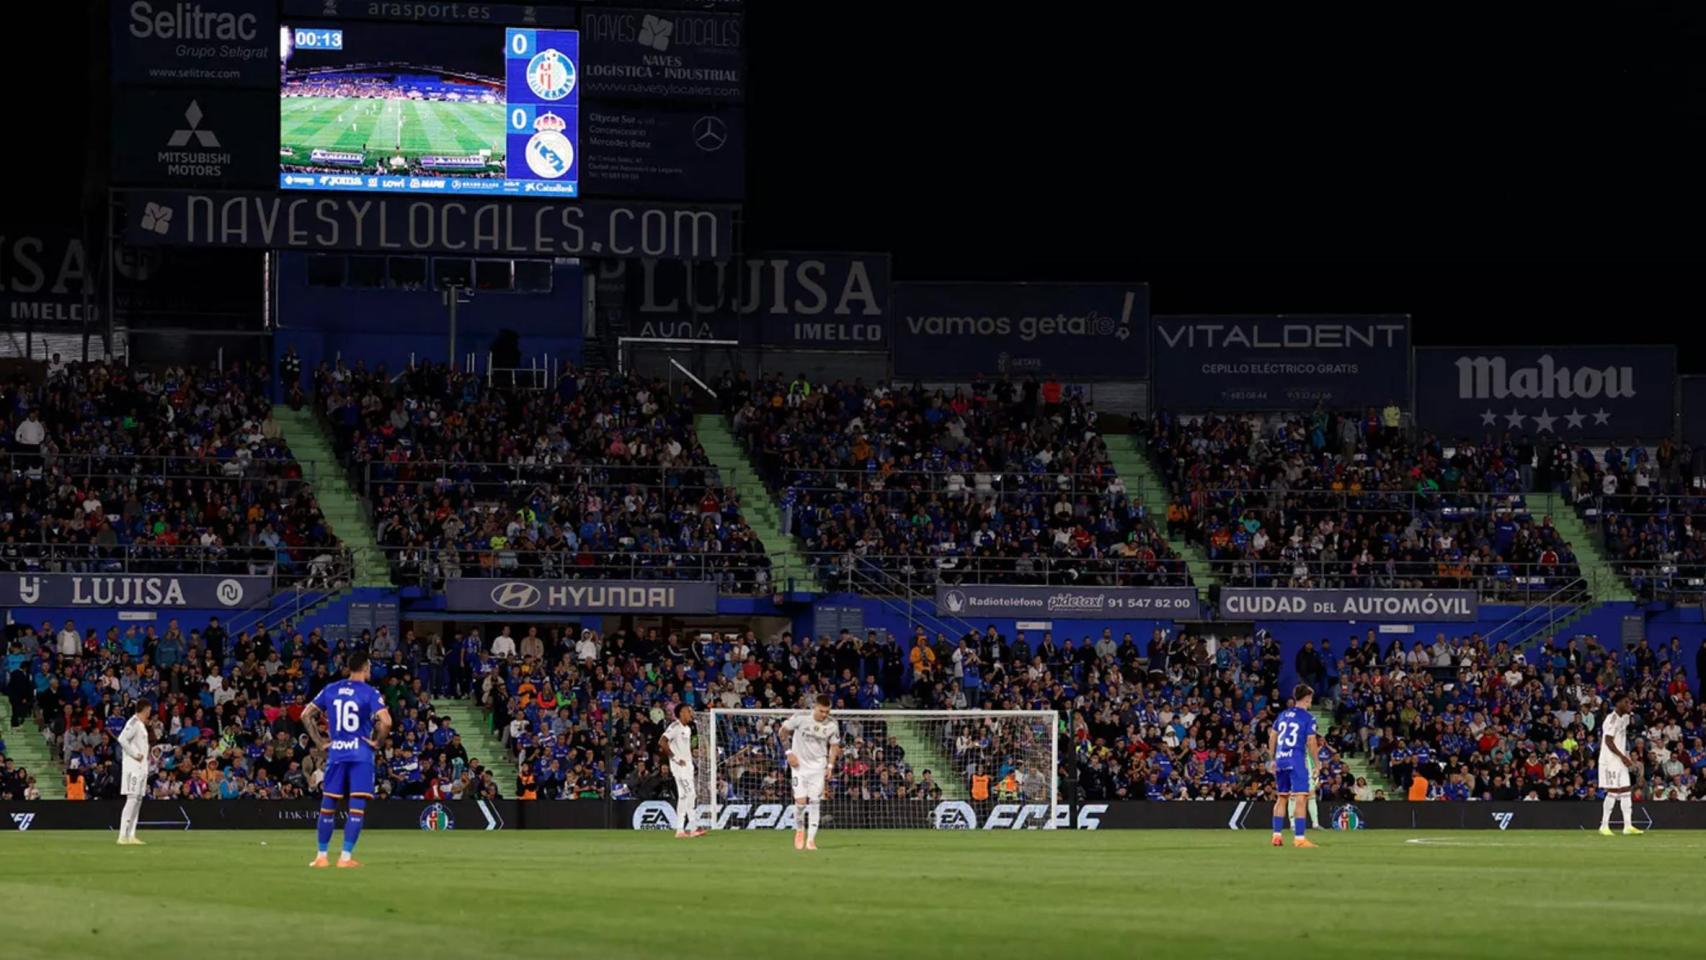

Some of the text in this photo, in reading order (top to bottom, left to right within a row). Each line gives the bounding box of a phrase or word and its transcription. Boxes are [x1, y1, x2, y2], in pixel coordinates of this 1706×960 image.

[129, 1, 257, 41] Selitrac
[368, 2, 491, 21] arasport.es
[296, 31, 342, 48] 00:13
[586, 14, 741, 48] NAVES LOCALES
[176, 44, 216, 59] Grupo
[512, 33, 528, 55] 0
[642, 55, 683, 68] NAVES
[150, 68, 240, 79] www.selitrac.com
[664, 68, 739, 82] INDUSTRIAL
[587, 83, 741, 97] www.navesylocales.com
[512, 108, 527, 130] 0
[157, 152, 231, 165] MITSUBISHI
[168, 166, 222, 177] MOTORS
[0, 236, 95, 295] SA
[639, 257, 882, 316] LUJISA
[11, 301, 99, 321] IMELCO
[794, 323, 882, 341] IMELCO
[906, 315, 1011, 335] vamos
[1158, 325, 1405, 348] VITALDENT
[1201, 361, 1360, 374] CEPILLO ELÉCTRICO GRATIS
[1454, 353, 1637, 399] Mahou
[72, 577, 186, 605] LUJISA
[548, 586, 675, 608] HYUNDAI
[968, 596, 1043, 608] Radioteléfono
[1108, 598, 1123, 608] 91
[1128, 598, 1151, 608] 547
[1155, 598, 1172, 608] 82
[1175, 598, 1191, 608] 00
[1225, 593, 1471, 616] CIUDAD DEL AUTOMÓVIL
[333, 699, 360, 733] 16
[1277, 721, 1300, 747] 23
[642, 808, 670, 824] EA
[940, 809, 968, 824] EA
